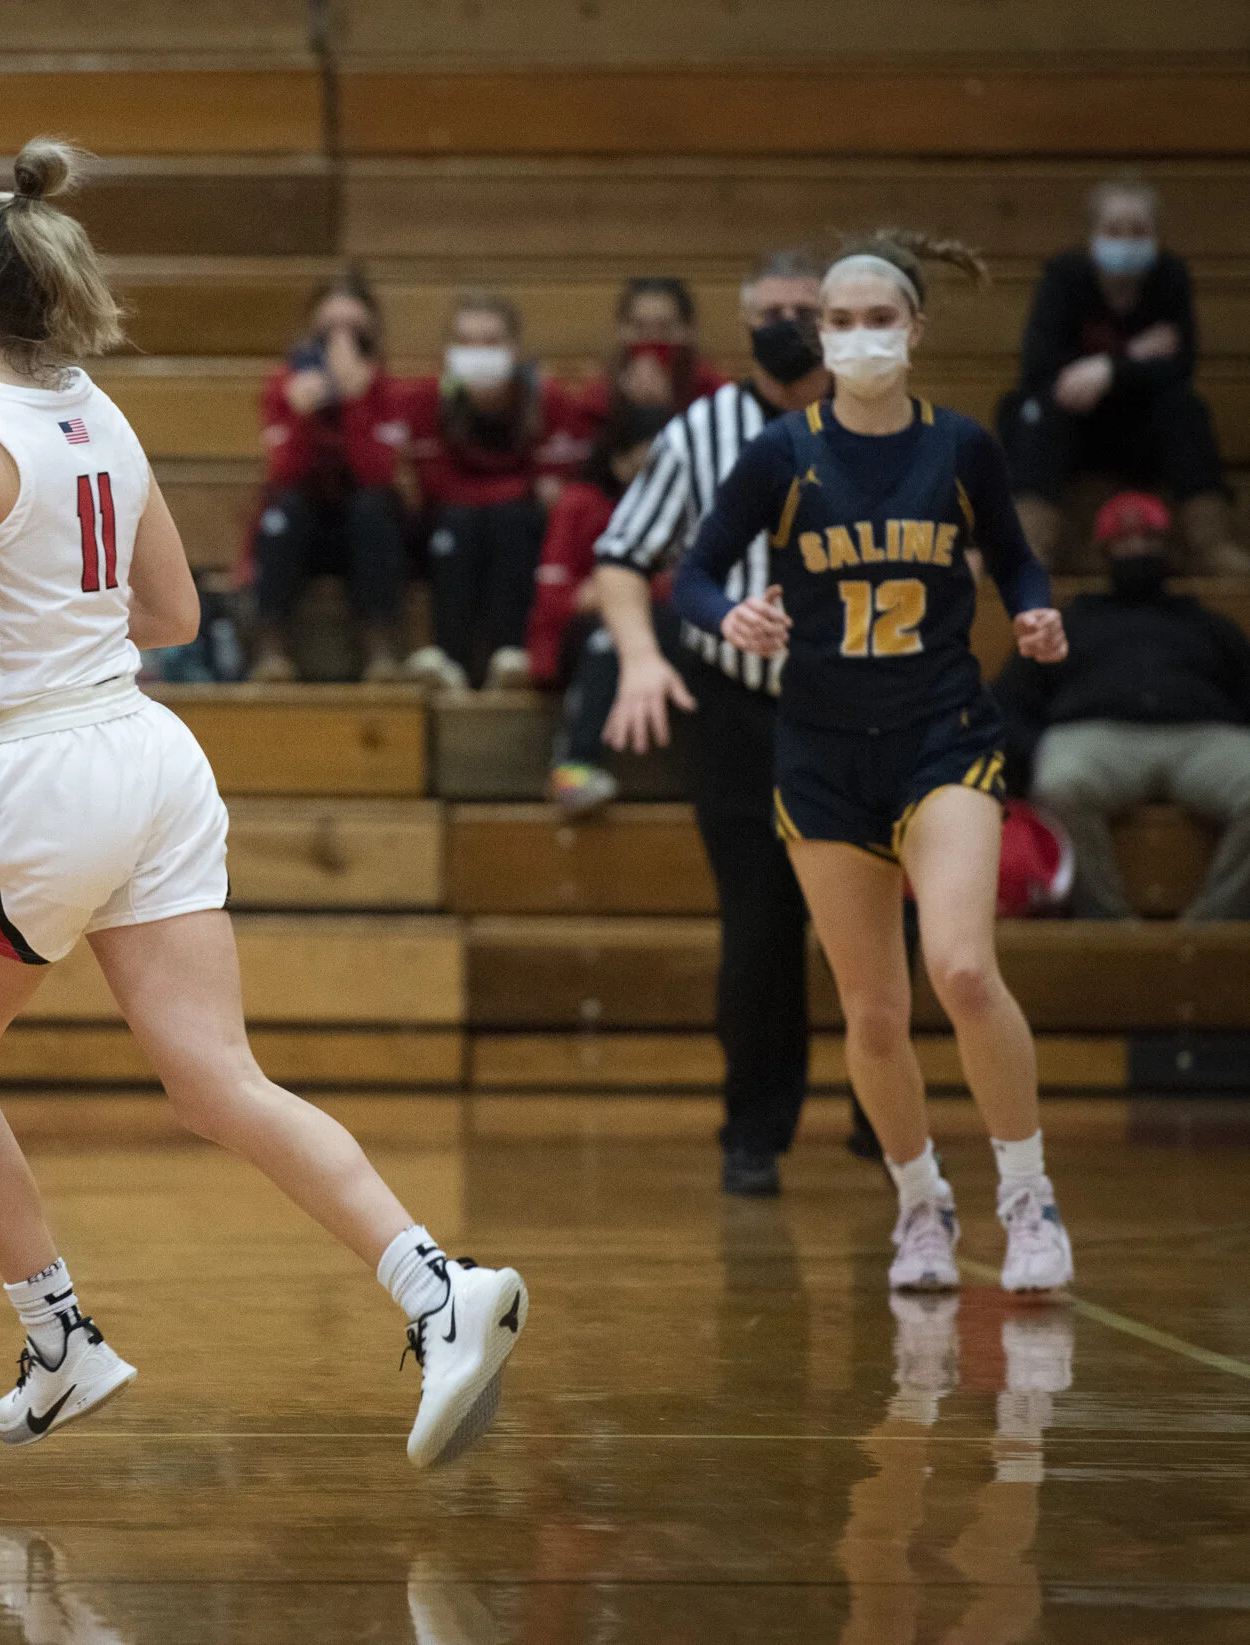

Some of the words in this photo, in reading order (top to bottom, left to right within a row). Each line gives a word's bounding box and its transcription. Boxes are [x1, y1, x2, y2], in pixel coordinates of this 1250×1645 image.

[77, 472, 118, 592] 11
[798, 519, 960, 574] SALINE
[838, 578, 926, 657] 12
